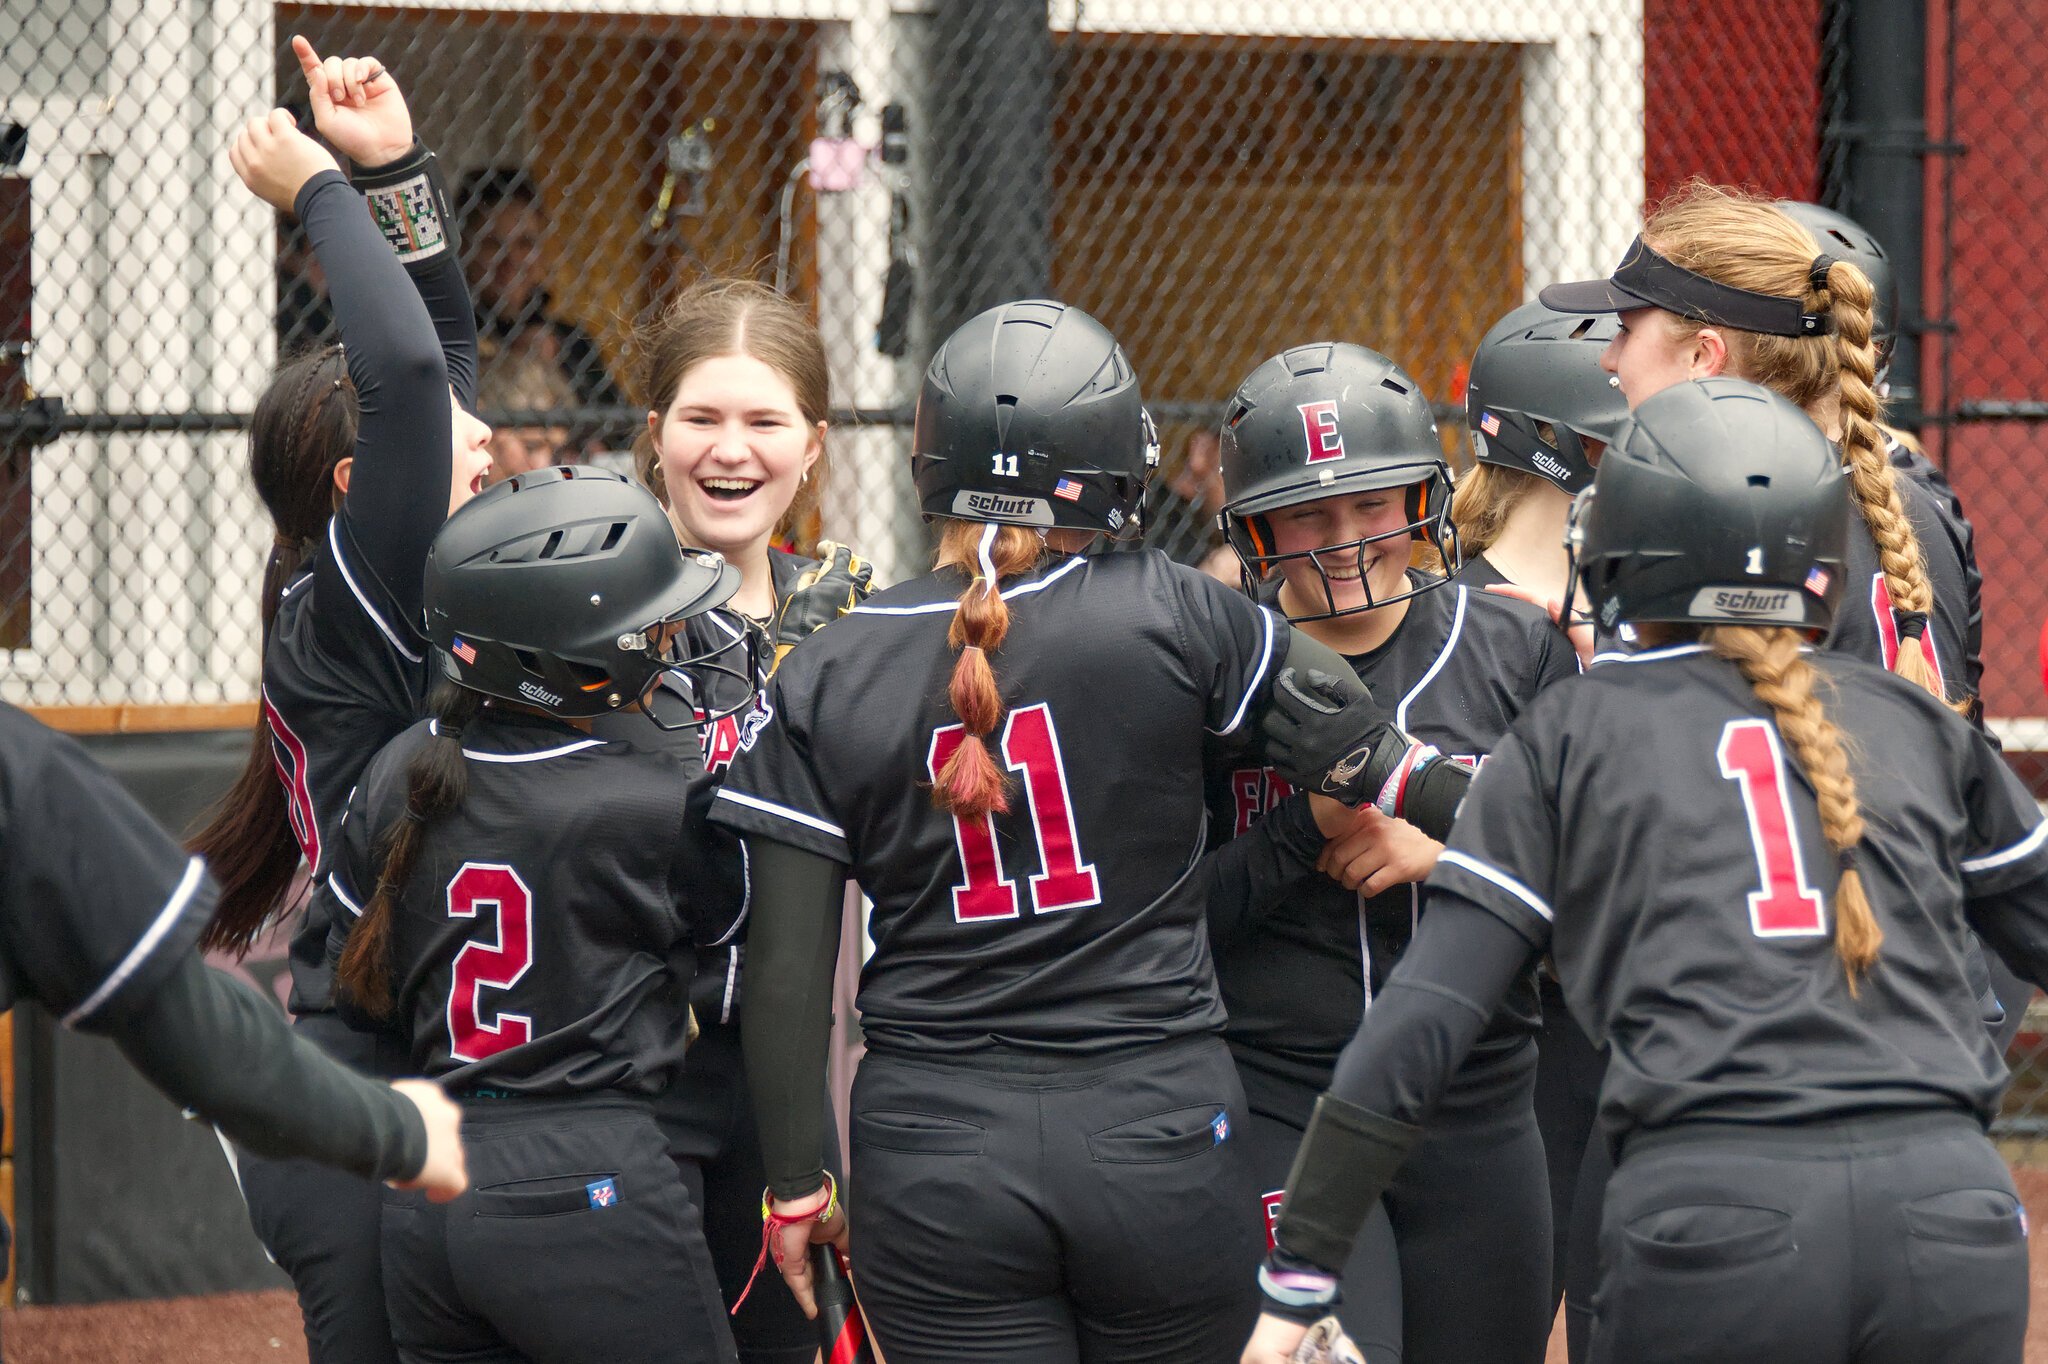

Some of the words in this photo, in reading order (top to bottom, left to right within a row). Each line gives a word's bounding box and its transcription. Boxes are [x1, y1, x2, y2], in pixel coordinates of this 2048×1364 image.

[1297, 400, 1345, 465] E
[991, 453, 1019, 477] 11
[1531, 451, 1572, 481] schutt
[967, 494, 1035, 514] schutt
[1745, 546, 1763, 575] 1
[1714, 590, 1790, 610] schutt
[518, 681, 563, 707] schutt
[926, 702, 1101, 923] 11
[1717, 719, 1826, 937] 1
[447, 862, 533, 1063] 2
